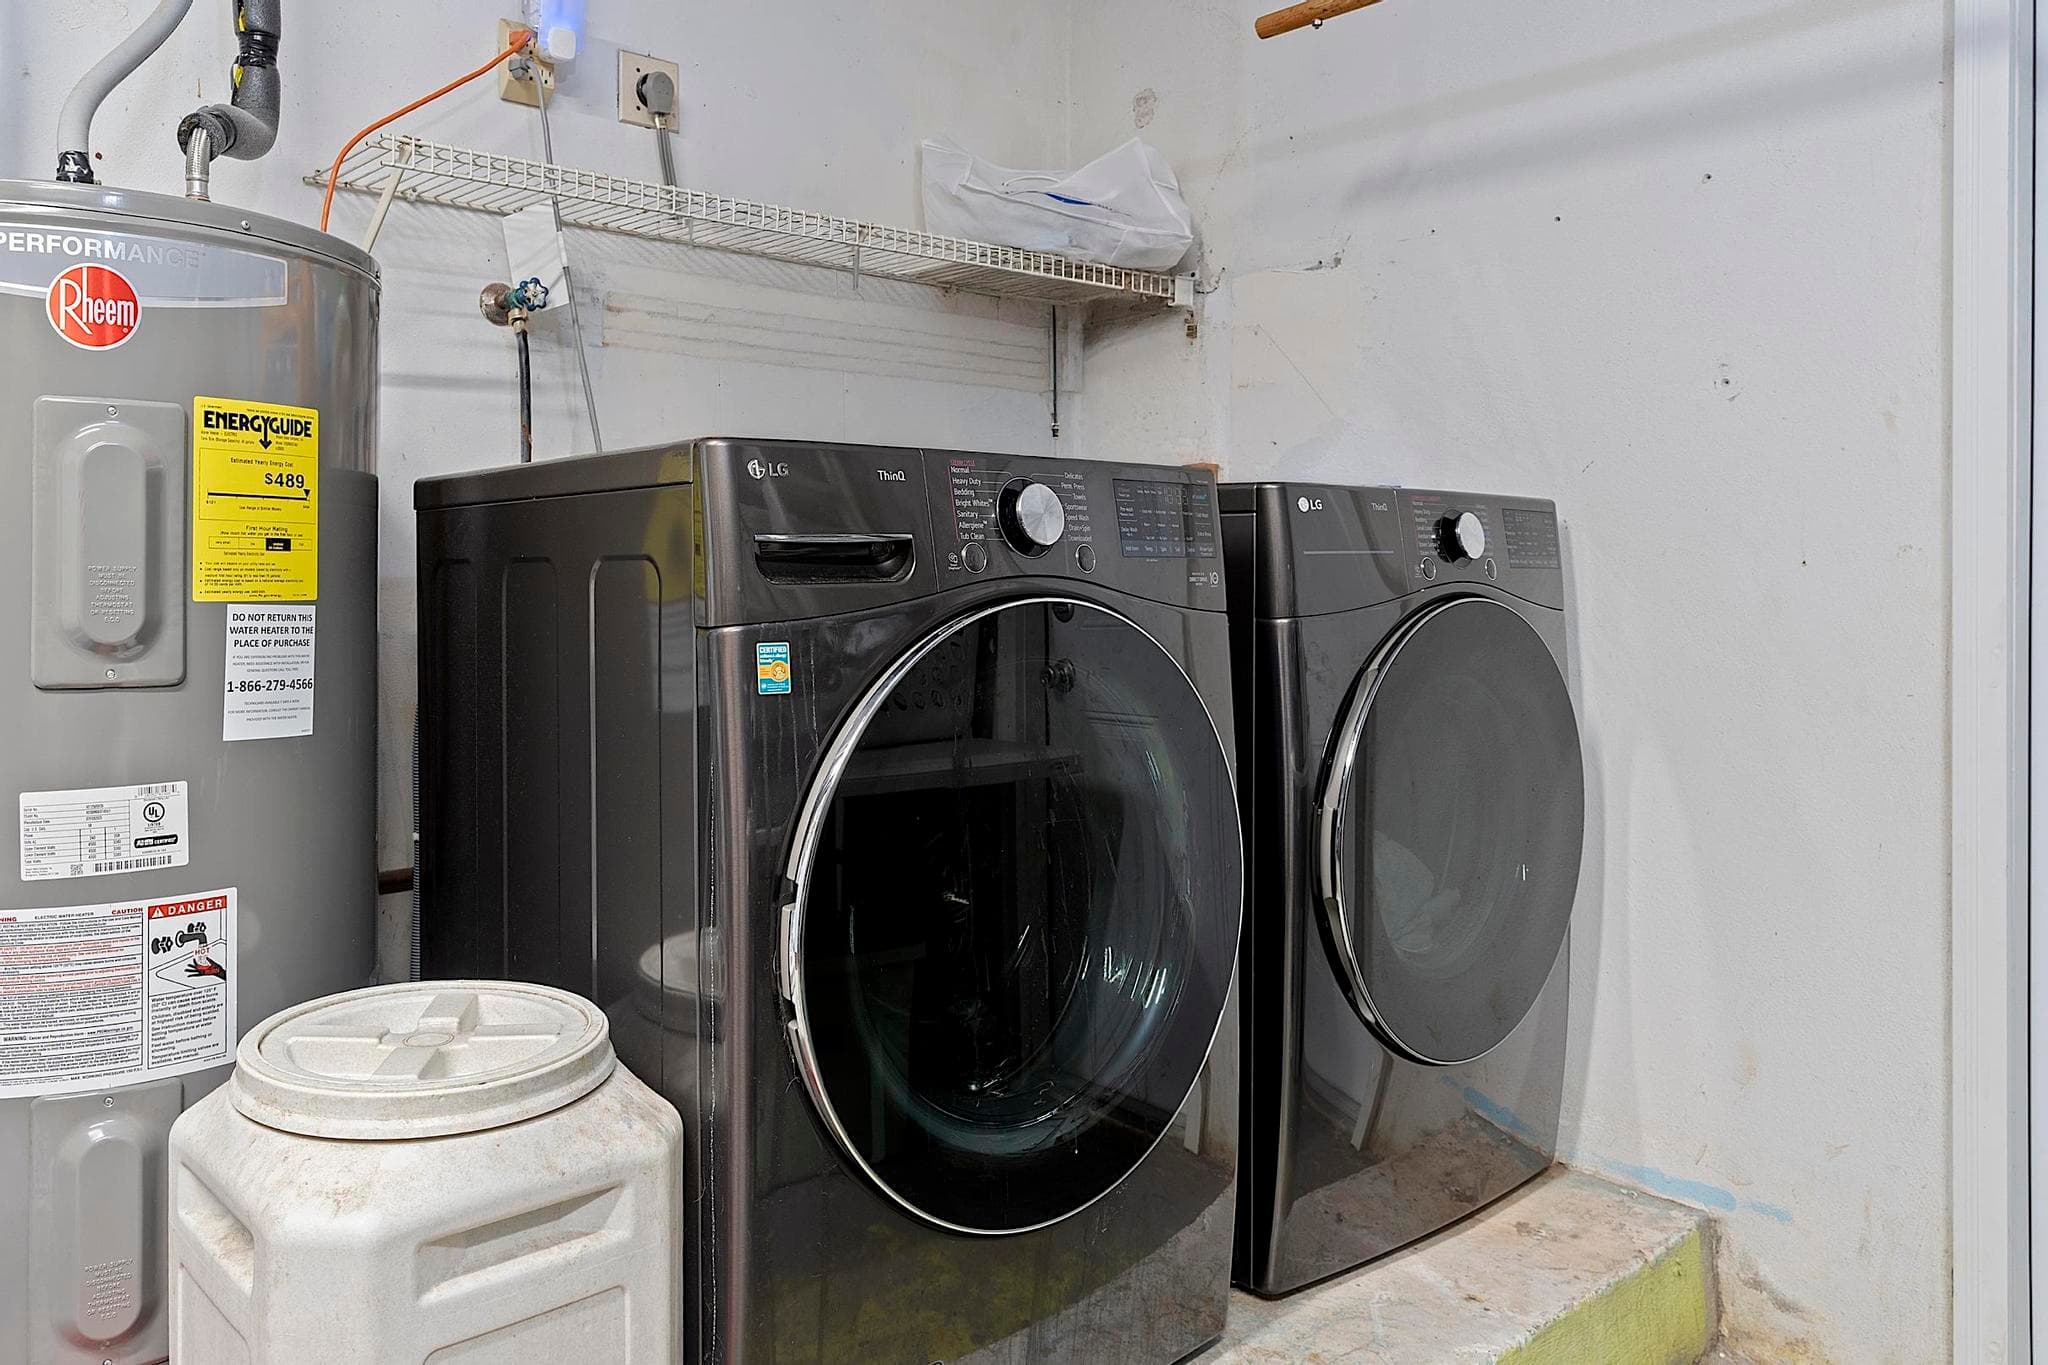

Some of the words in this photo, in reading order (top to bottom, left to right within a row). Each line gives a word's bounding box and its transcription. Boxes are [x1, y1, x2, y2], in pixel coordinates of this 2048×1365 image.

[59, 265, 134, 334] Rheem
[204, 410, 312, 439] ENERGYGUIDE
[768, 462, 789, 477] LG
[877, 470, 906, 482] ThinQ
[952, 478, 968, 486] Heavy
[969, 478, 982, 487] Duty
[954, 489, 975, 497] Bedding
[1310, 499, 1323, 510] LG
[1371, 502, 1388, 511] ThinQ
[957, 510, 979, 519] Sanitary
[267, 614, 296, 622] RETURN
[274, 639, 310, 647] PURCHASE
[227, 678, 313, 693] 1-866-279-4566
[149, 807, 160, 818] UL
[168, 900, 222, 915] DANGER
